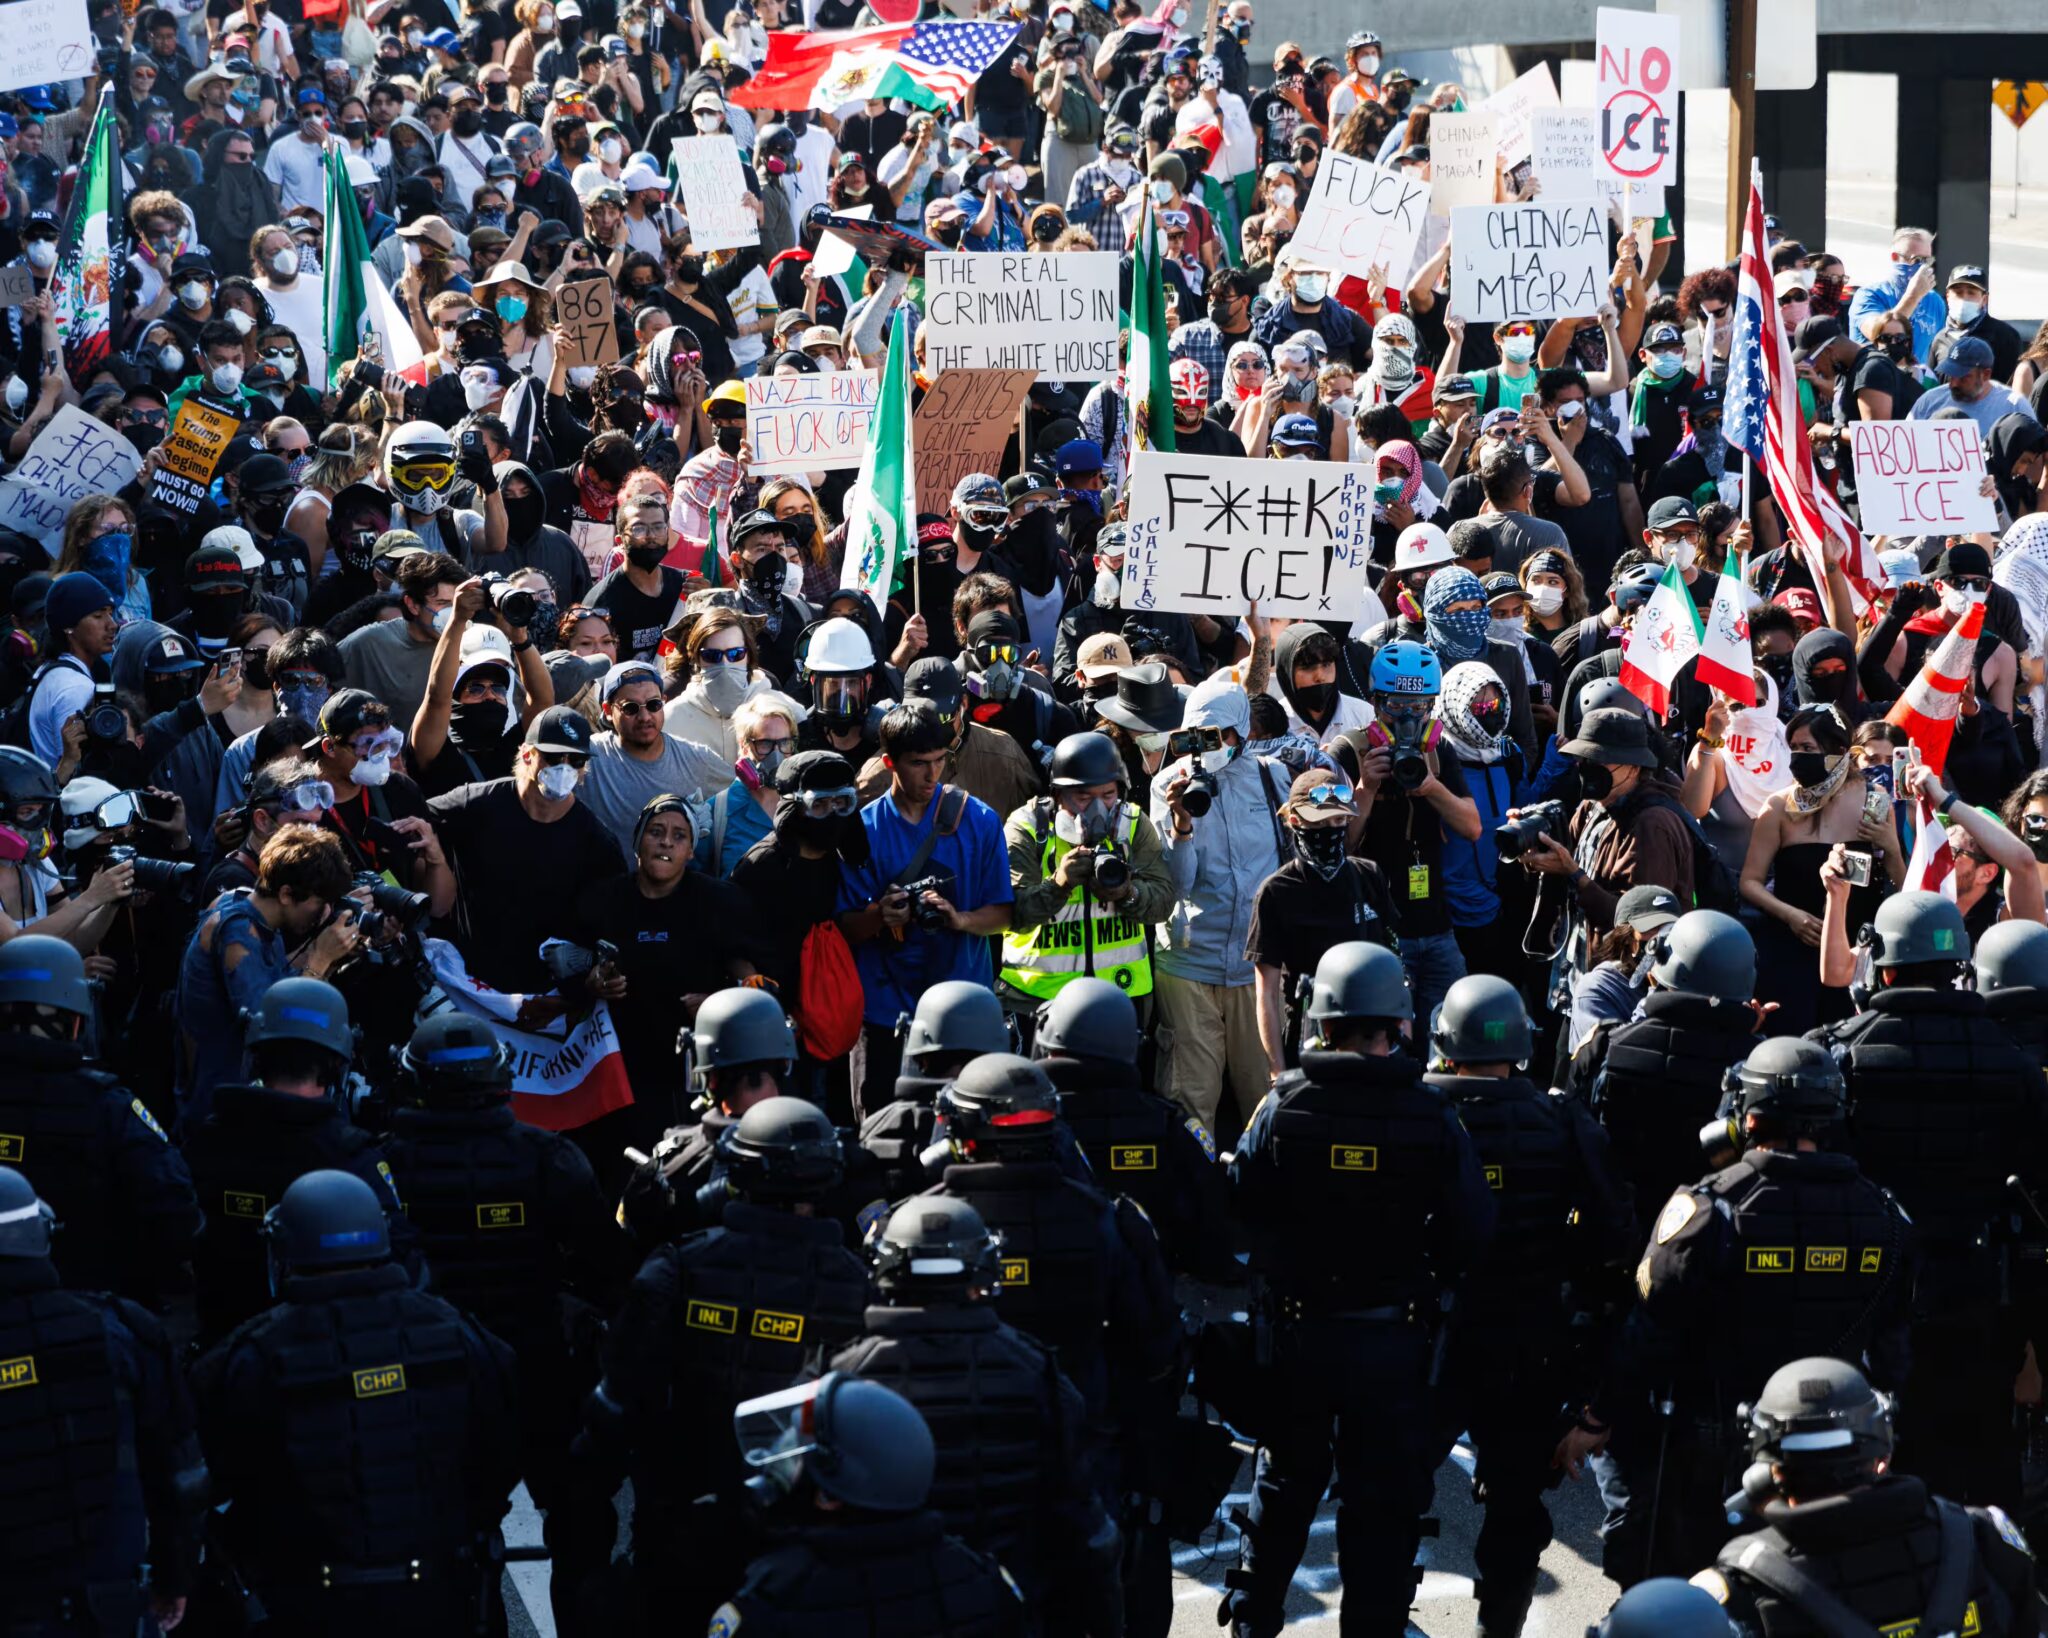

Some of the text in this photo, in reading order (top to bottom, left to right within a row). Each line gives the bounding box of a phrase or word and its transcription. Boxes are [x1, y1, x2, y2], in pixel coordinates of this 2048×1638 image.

[28, 22, 52, 34] AND
[12, 58, 46, 77] HERE
[1600, 44, 1671, 95] NO
[1437, 126, 1490, 142] CHINGA
[1602, 109, 1670, 154] ICE
[1456, 147, 1475, 157] TU
[1436, 159, 1482, 178] MAGA!
[1326, 158, 1422, 233] FUCK
[1487, 207, 1603, 249] CHINGA
[930, 257, 1068, 285] THE REAL
[1510, 252, 1544, 280] LA
[3, 277, 26, 296] ICE
[561, 282, 602, 320] 86
[1477, 266, 1598, 319] MIGRA
[931, 288, 1114, 326] CRIMINAL IS IN
[570, 321, 609, 362] 47
[930, 341, 1117, 375] THE WHITE HOUSE
[748, 376, 879, 406] NAZI PUNKS
[182, 417, 222, 445] Trump
[200, 410, 220, 426] The
[174, 432, 217, 461] ascist
[755, 410, 831, 461] FUCK
[922, 421, 981, 452] GENTE
[1856, 425, 1984, 477] ABOLISH
[19, 455, 94, 500] CHING
[154, 468, 205, 499] MUST GO
[1025, 474, 1040, 489] LA
[7, 487, 65, 532] MAD
[152, 485, 199, 514] NOW!!!
[1892, 480, 1966, 522] ICE
[1334, 472, 1355, 561] BROWN
[1349, 484, 1367, 569] PRIDE
[1126, 522, 1144, 583] SUR
[1135, 516, 1161, 610] CALIFAS
[1103, 645, 1118, 660] NY
[1396, 676, 1423, 691] PRESS
[1123, 1151, 1143, 1160] CHP
[1344, 1151, 1364, 1159] CHP
[490, 1207, 510, 1217] CHP
[1756, 1252, 1842, 1268] INL CHP
[698, 1308, 797, 1335] INL CHP
[360, 1371, 399, 1392] CHP
